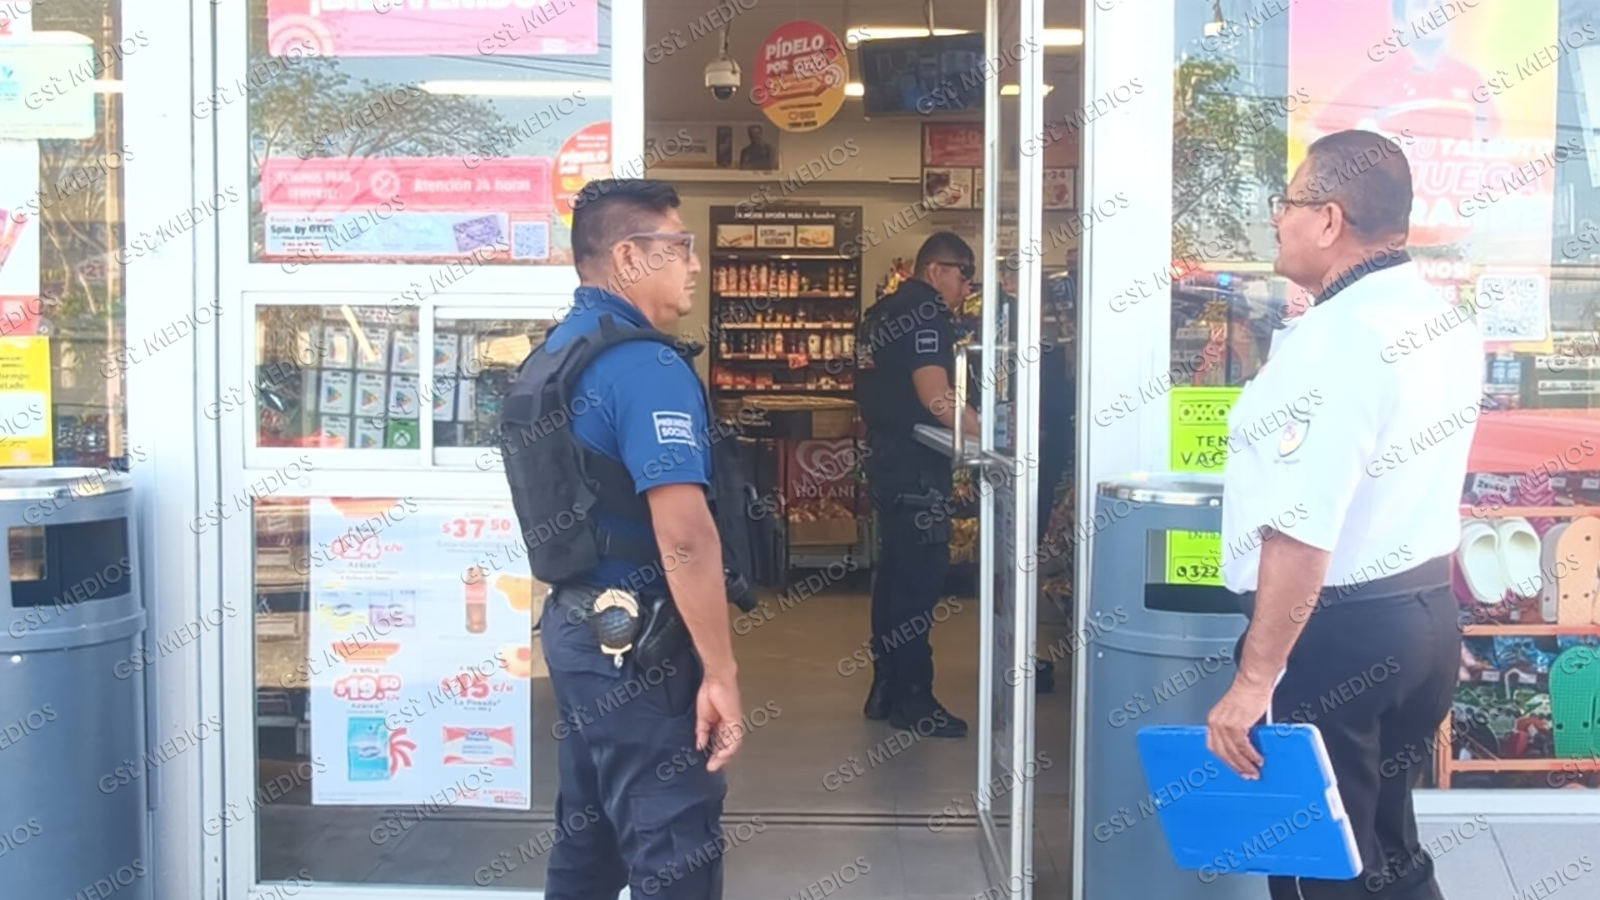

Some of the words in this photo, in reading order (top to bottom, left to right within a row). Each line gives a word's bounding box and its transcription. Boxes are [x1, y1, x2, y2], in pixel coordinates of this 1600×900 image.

[765, 34, 824, 60] PÍDELO
[414, 177, 471, 192] Atención
[271, 224, 291, 234] Spin
[294, 225, 306, 236] by
